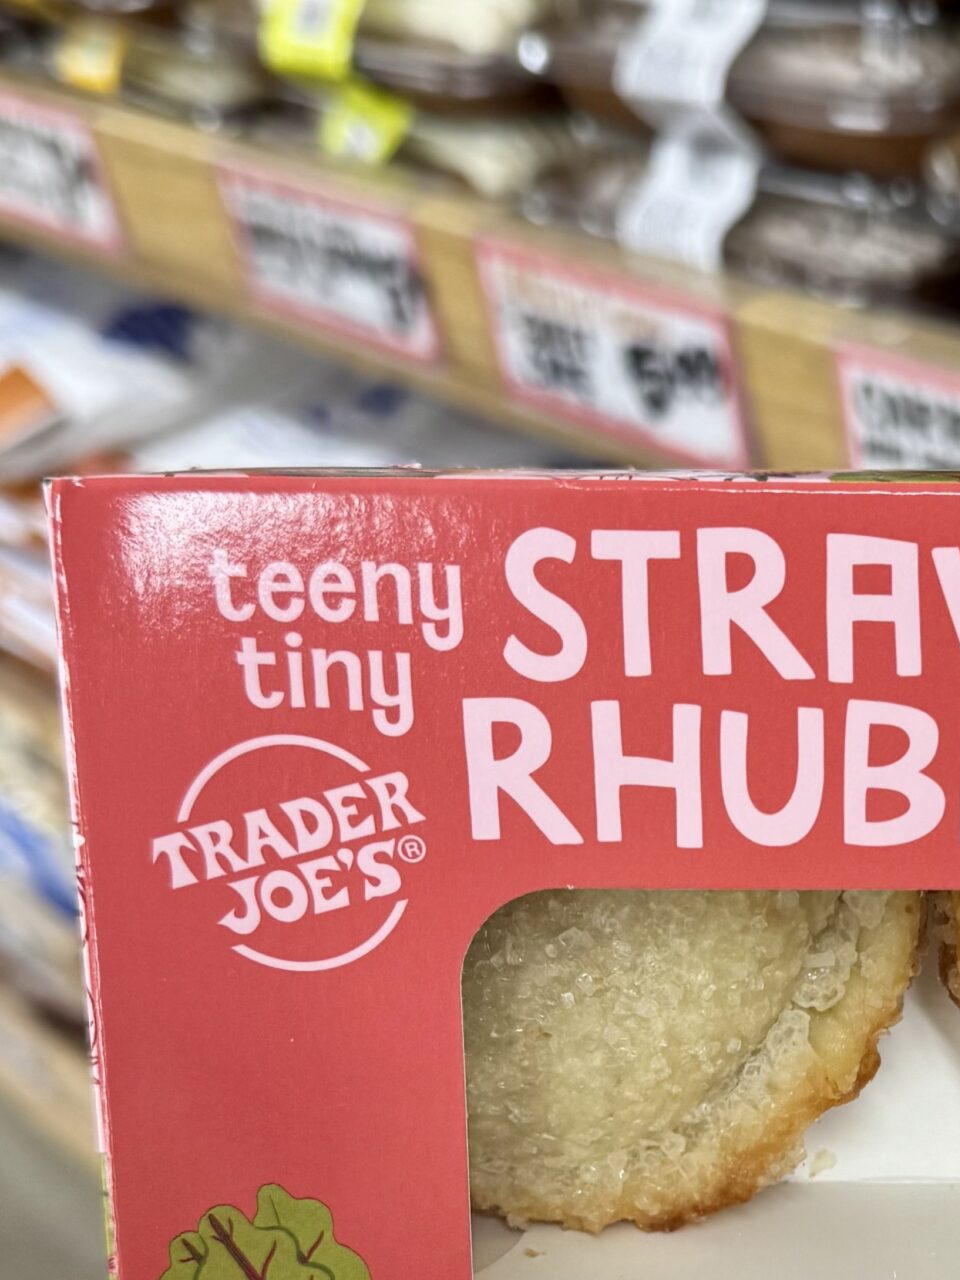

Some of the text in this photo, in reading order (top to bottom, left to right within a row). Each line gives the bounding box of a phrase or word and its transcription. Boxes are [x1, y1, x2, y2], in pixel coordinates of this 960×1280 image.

[208, 550, 464, 652] teeny
[236, 632, 414, 737] tiny
[152, 771, 427, 890] TRADER
